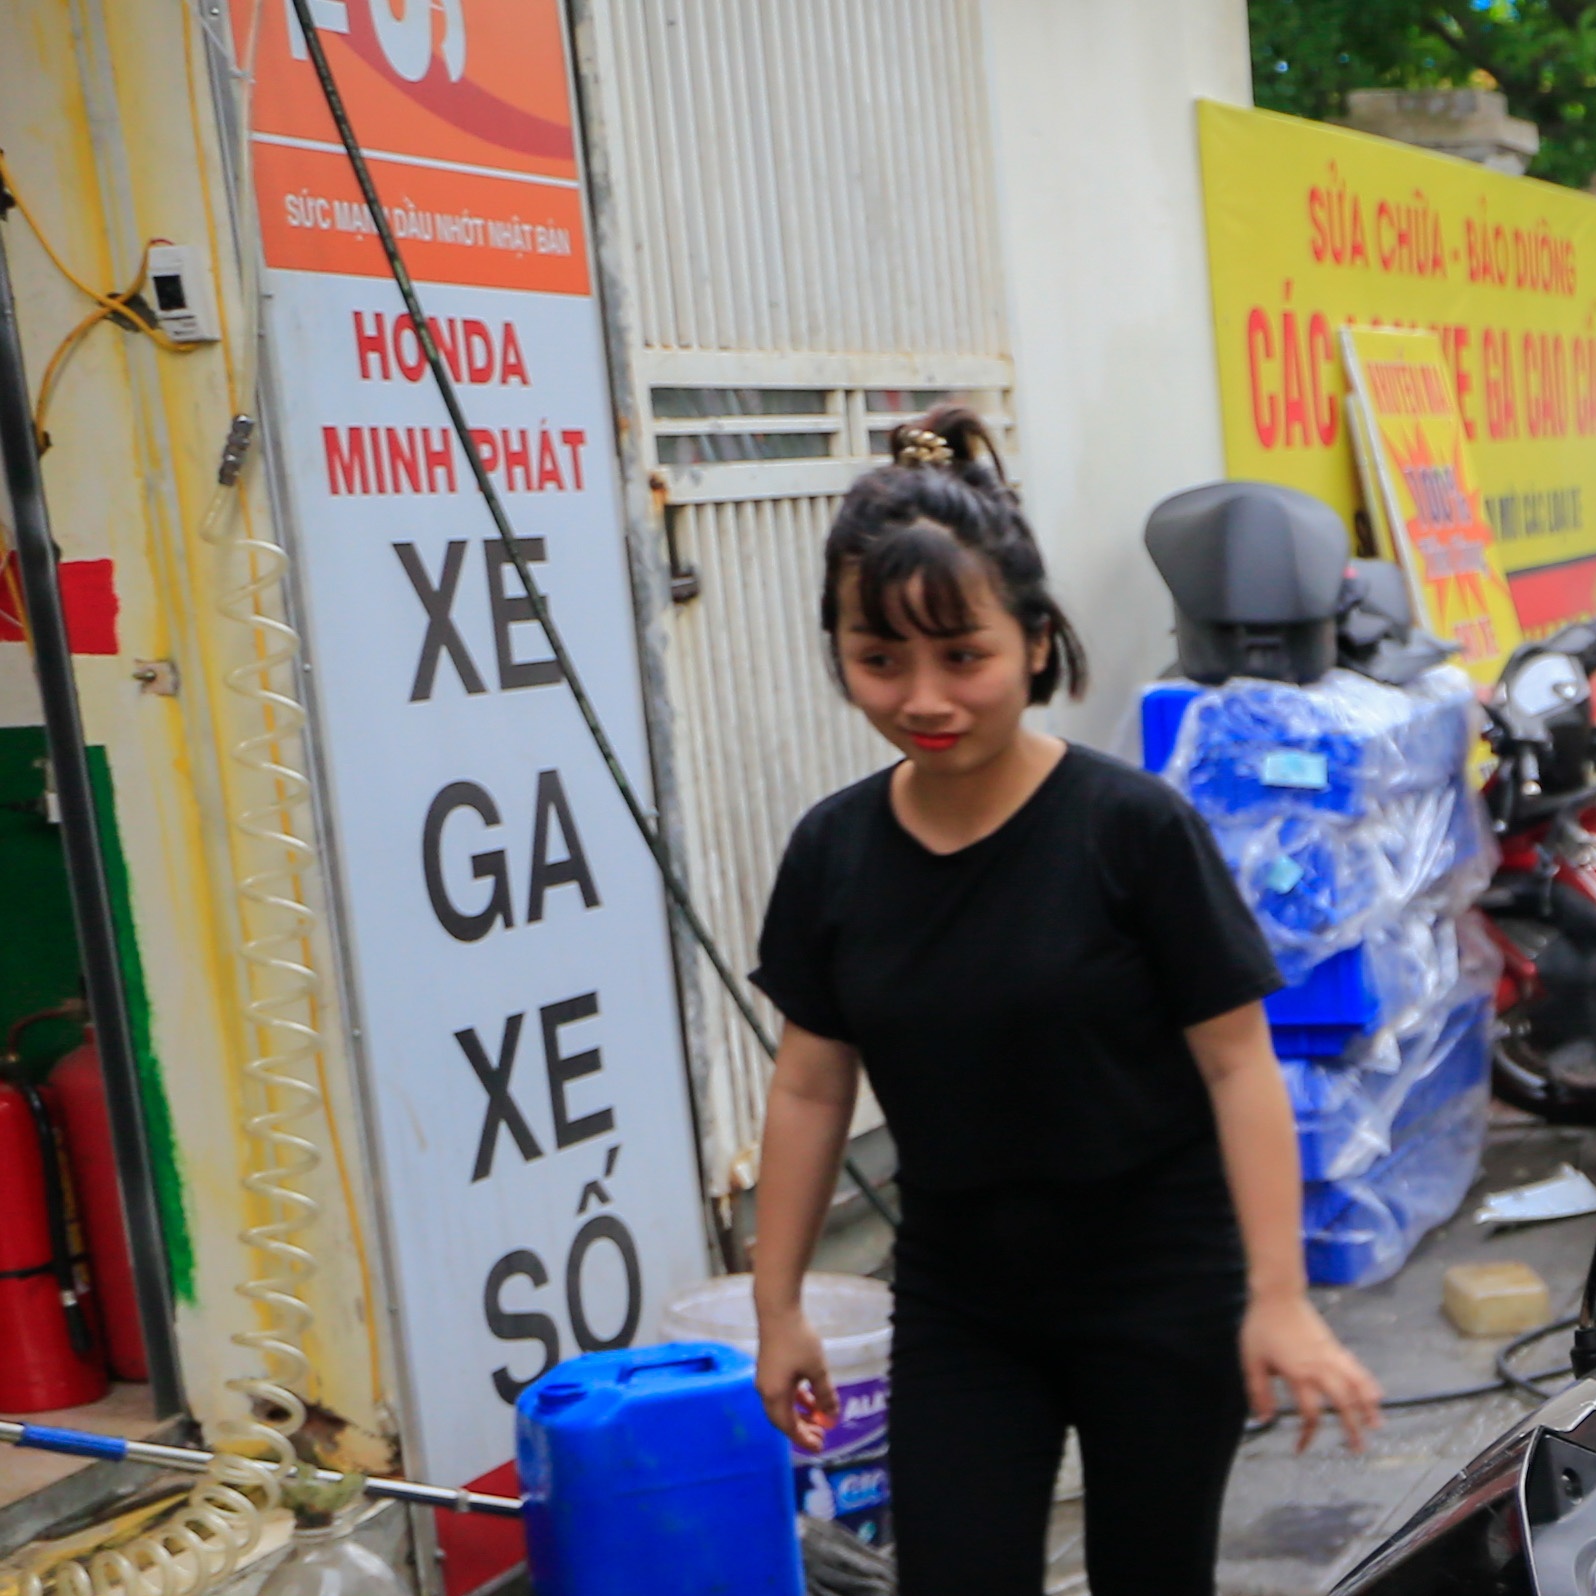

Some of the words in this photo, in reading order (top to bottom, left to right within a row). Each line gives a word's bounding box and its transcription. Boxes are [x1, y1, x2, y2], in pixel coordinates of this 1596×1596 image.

[284, 188, 332, 231] SỨC
[392, 196, 434, 241] DẦU
[435, 209, 485, 246] NHỚT
[488, 215, 534, 258] NHẬT
[536, 219, 572, 256] BẢN
[1308, 160, 1370, 268] SỬA
[352, 310, 532, 388] HONDA
[1247, 279, 1339, 449] CÁC
[1483, 328, 1520, 441] GA
[1523, 331, 1569, 439] CAO
[322, 426, 457, 496] MINH
[468, 418, 587, 494] PHÁT
[391, 536, 566, 703] XE
[421, 768, 601, 943] GA
[453, 991, 616, 1184] XE
[484, 1144, 643, 1405] SỐ
